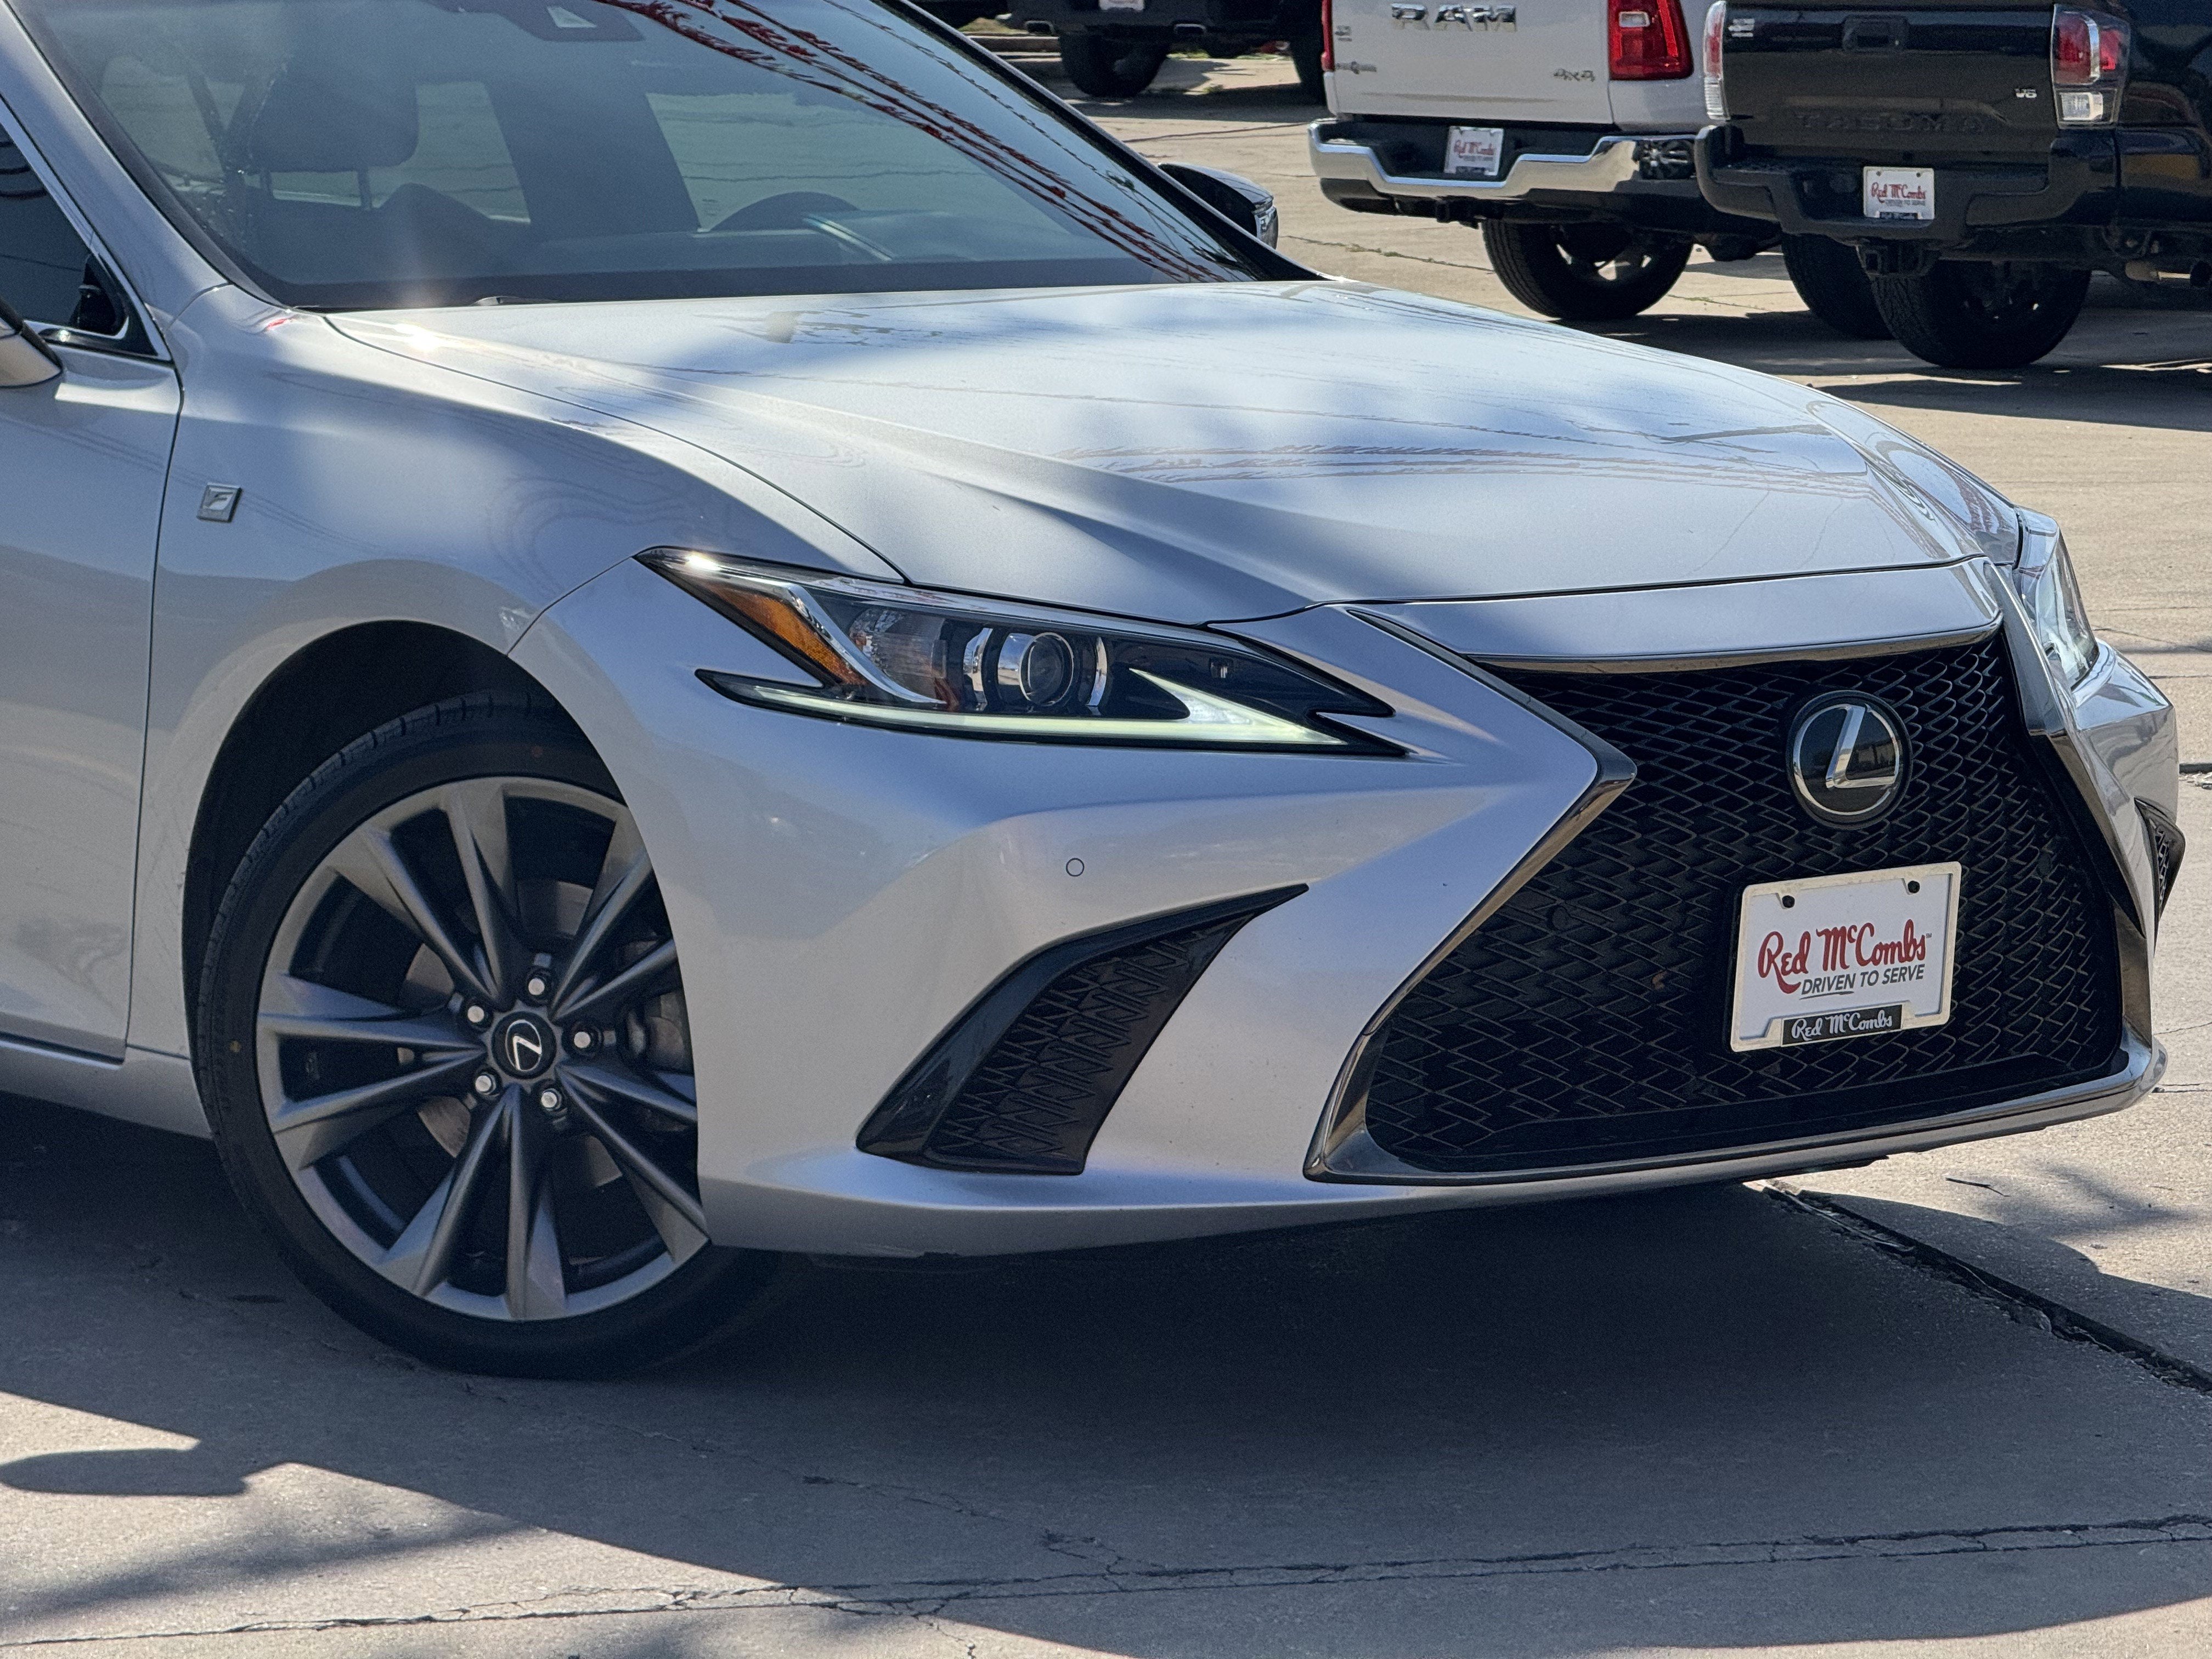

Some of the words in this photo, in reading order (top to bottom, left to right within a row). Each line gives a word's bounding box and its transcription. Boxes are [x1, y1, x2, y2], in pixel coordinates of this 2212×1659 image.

[1391, 3, 1517, 32] RAM
[1758, 931, 1811, 994] Red
[1816, 919, 1926, 971] McCombs
[1802, 973, 1856, 995] DRIVEN
[1860, 970, 1880, 988] TO
[1882, 964, 1926, 985] SERVE
[1791, 1018, 1823, 1041] Red
[1825, 1009, 1893, 1034] McCombs
